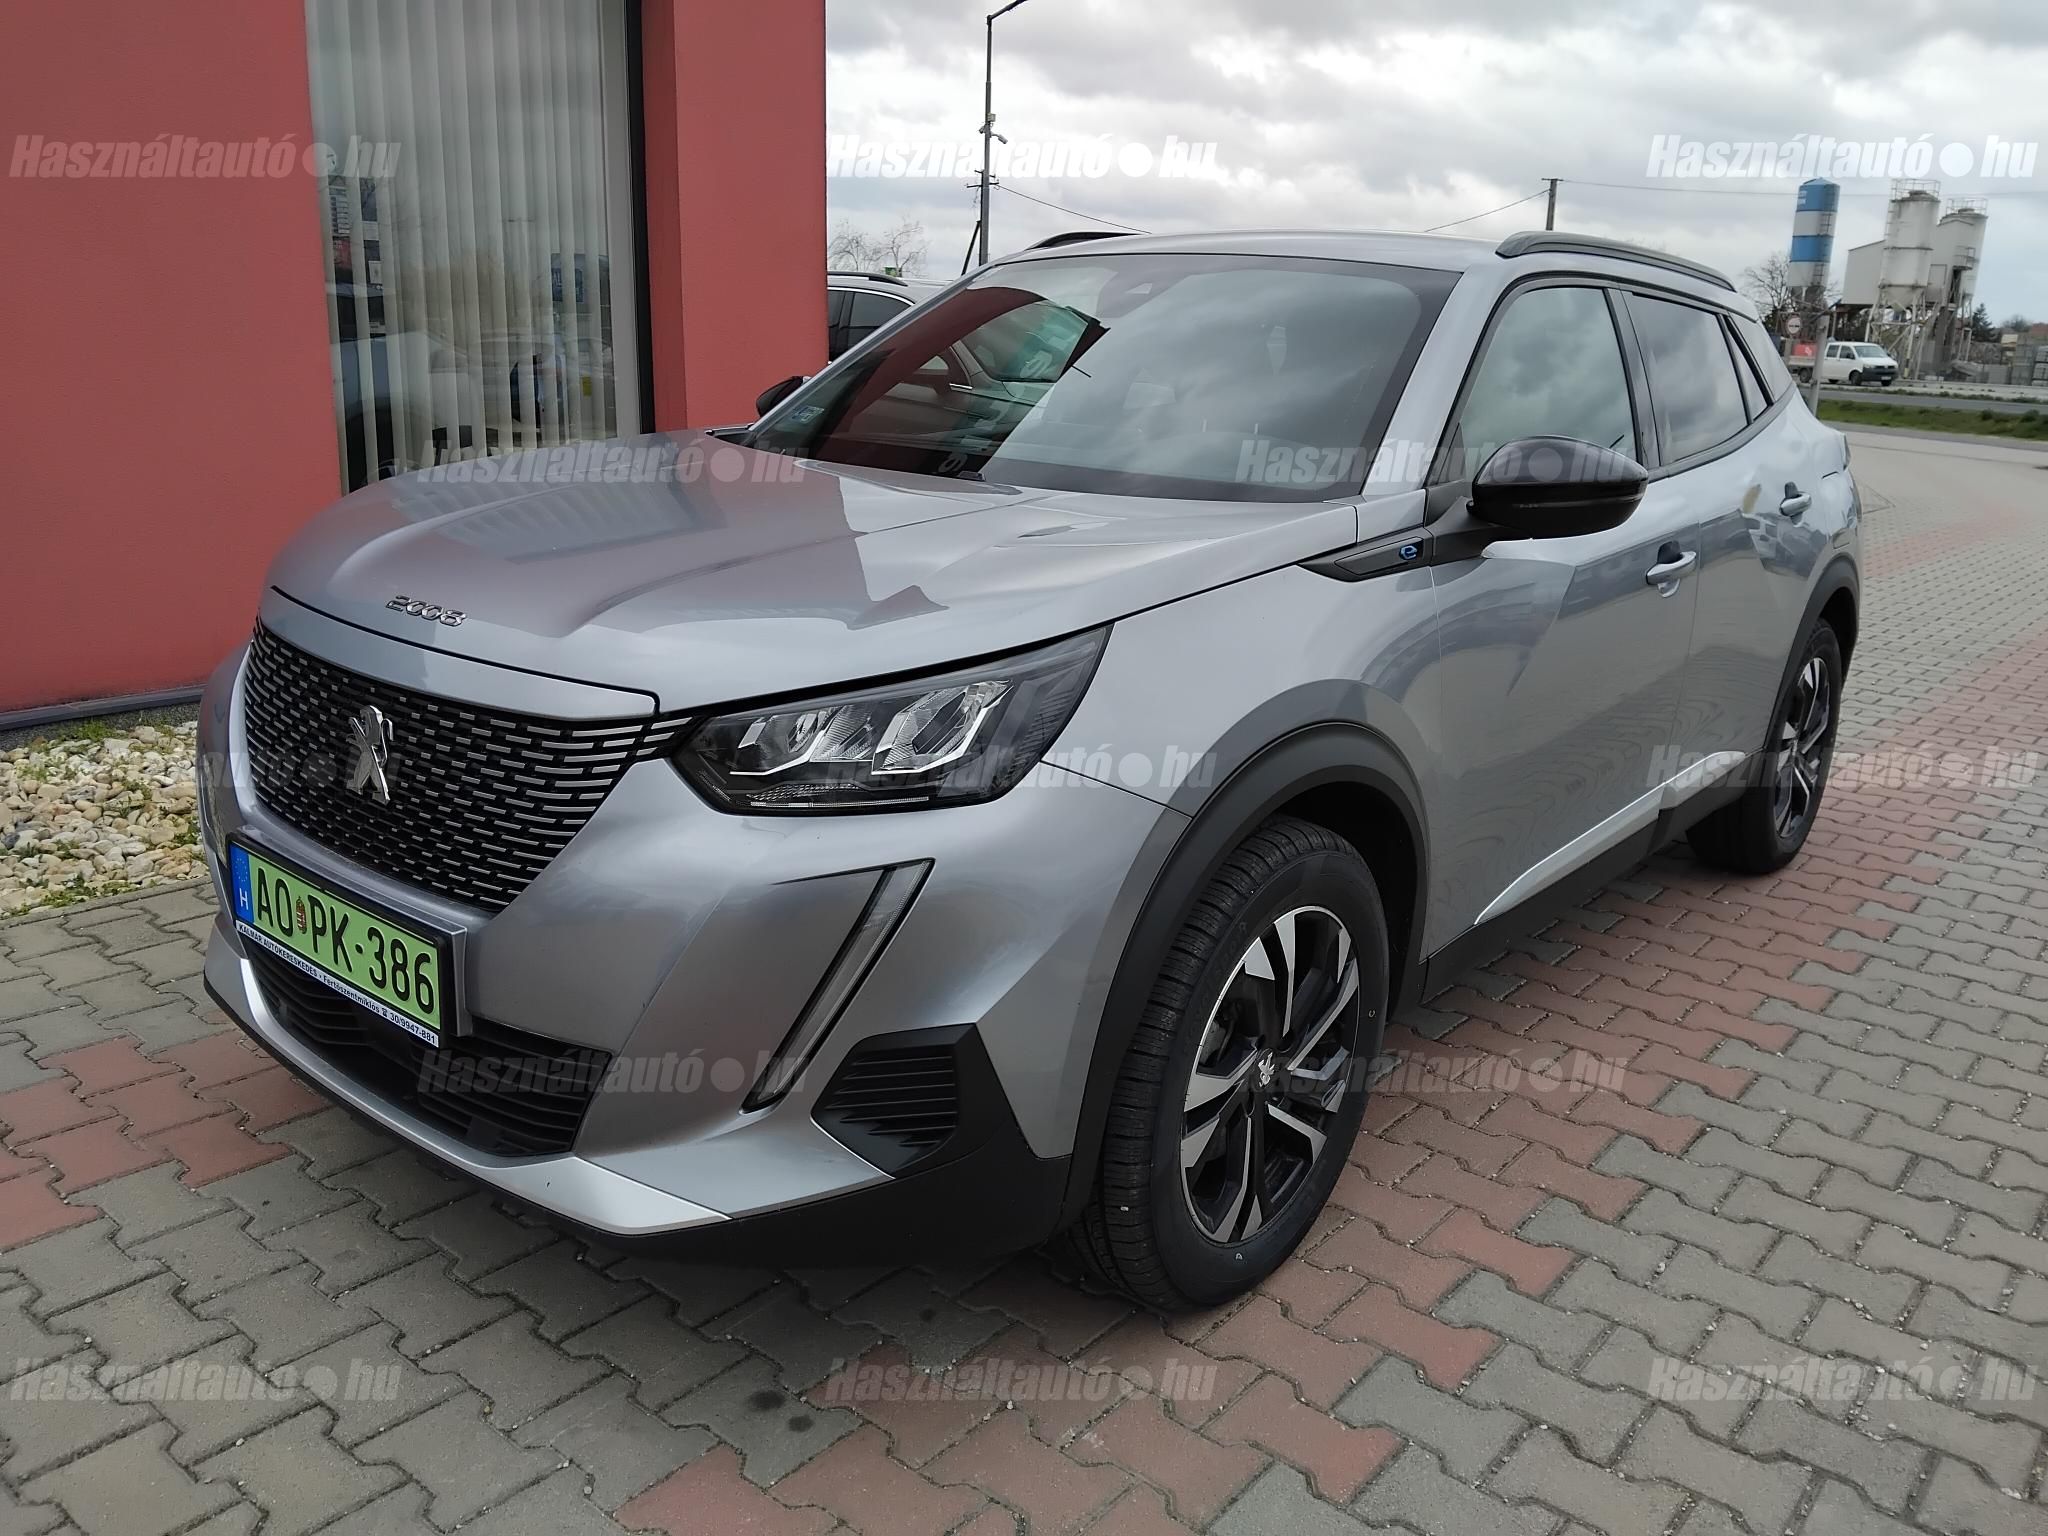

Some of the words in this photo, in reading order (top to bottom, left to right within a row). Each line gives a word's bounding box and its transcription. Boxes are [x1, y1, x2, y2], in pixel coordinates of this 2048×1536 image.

[385, 595, 467, 627] 2008
[239, 887, 249, 911] H
[256, 867, 294, 937] AO
[306, 894, 435, 1015] PK-386
